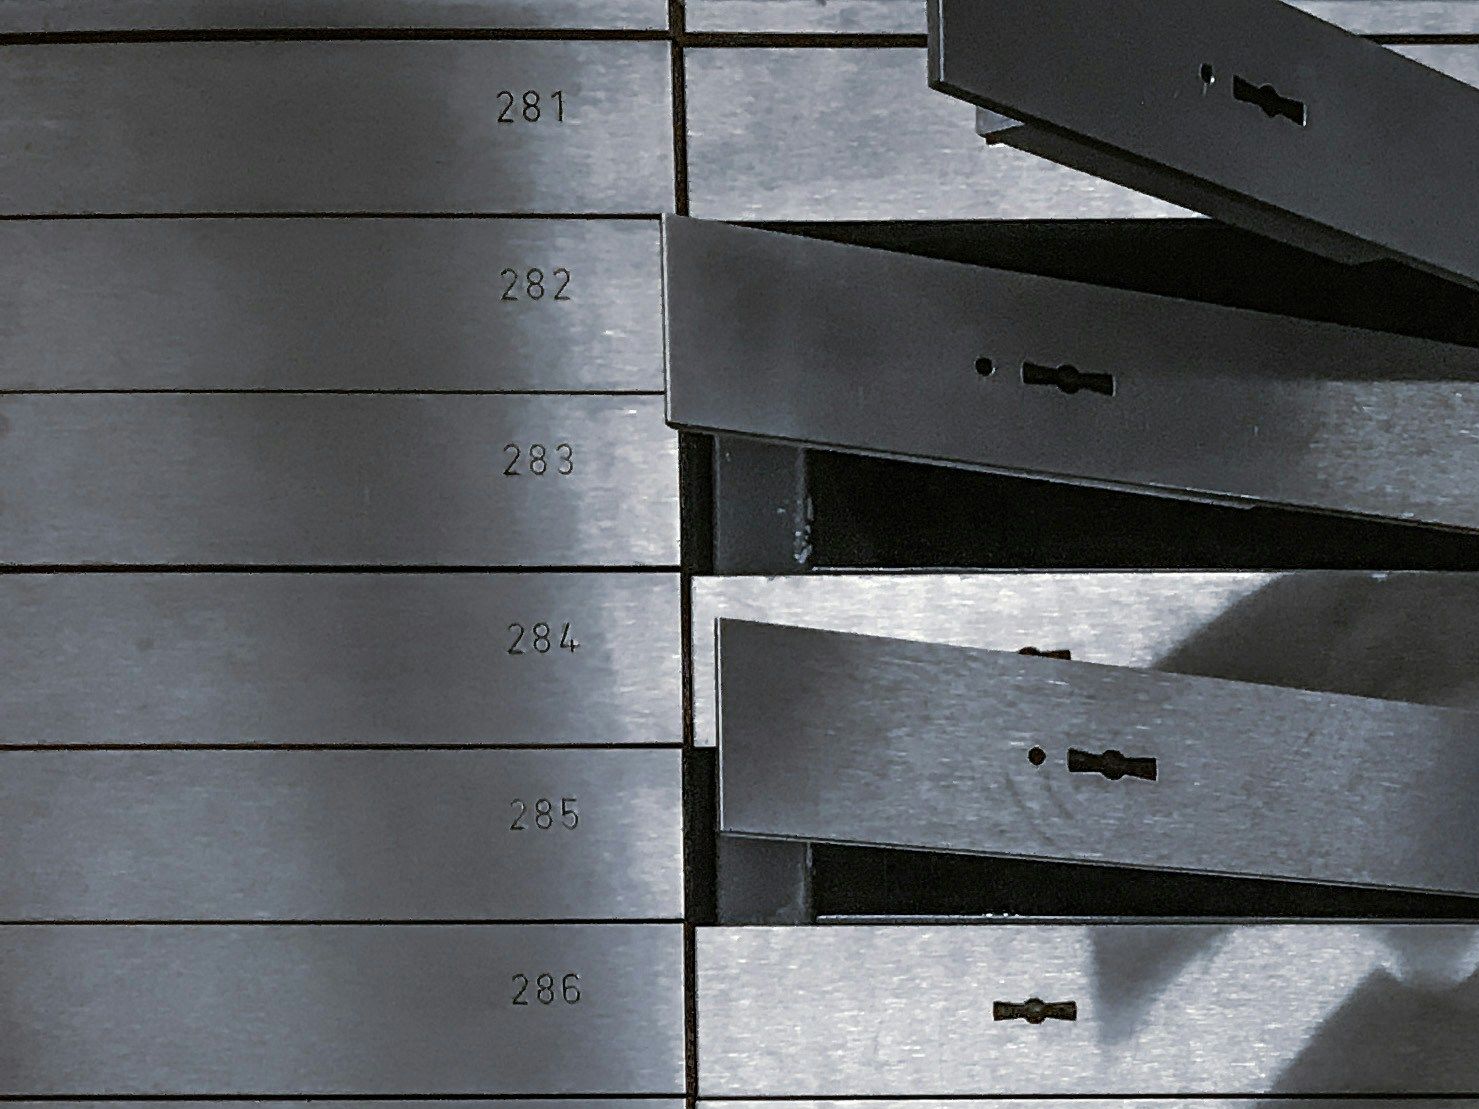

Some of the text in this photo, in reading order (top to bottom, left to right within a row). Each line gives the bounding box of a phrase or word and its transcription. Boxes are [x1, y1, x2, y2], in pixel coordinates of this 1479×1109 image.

[496, 90, 564, 124] 281
[500, 267, 572, 302] 282
[502, 442, 574, 476] 283
[507, 621, 581, 655] 284
[509, 797, 579, 831] 285
[511, 973, 582, 1006] 286
